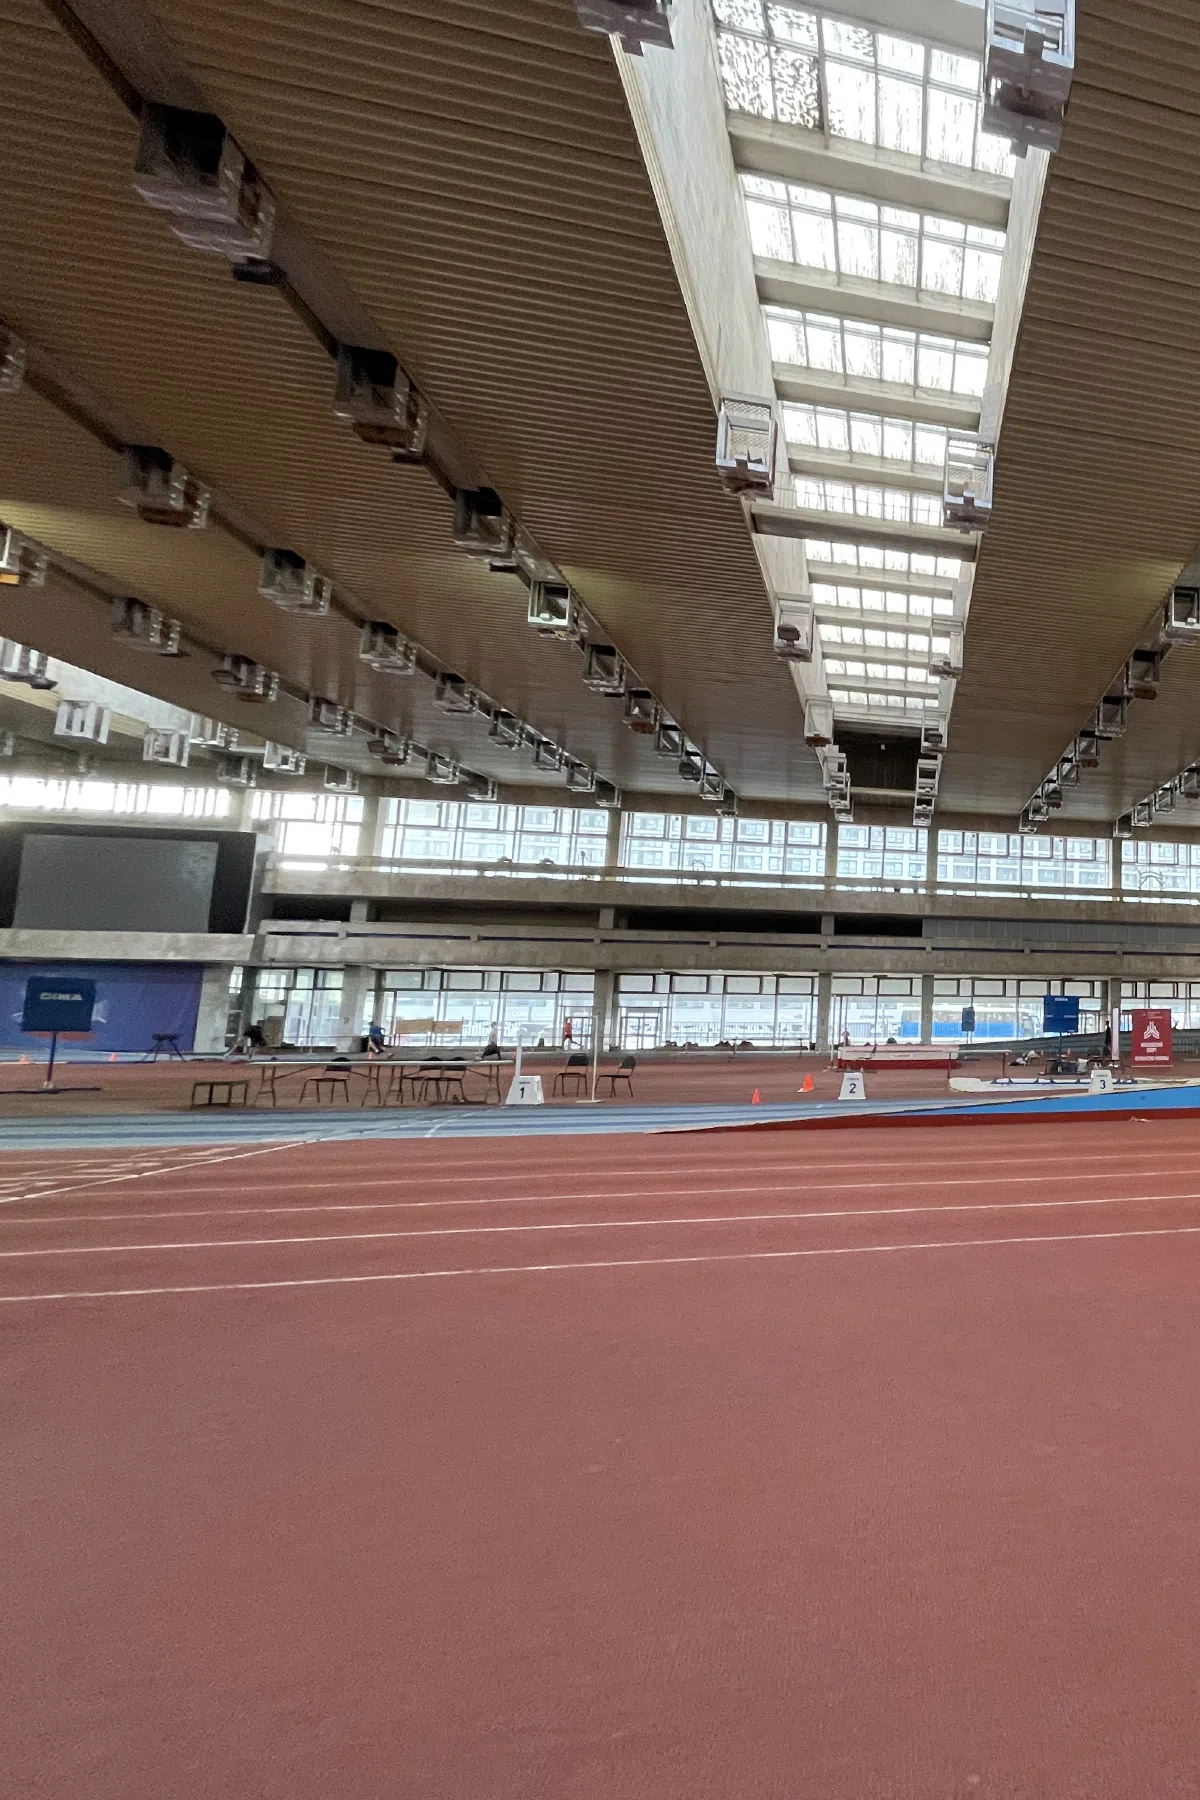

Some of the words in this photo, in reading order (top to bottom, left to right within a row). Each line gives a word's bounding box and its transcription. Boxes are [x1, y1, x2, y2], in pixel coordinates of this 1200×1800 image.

[849, 1082, 857, 1094] 2
[1099, 1079, 1107, 1090] 3
[519, 1086, 525, 1099] 1
